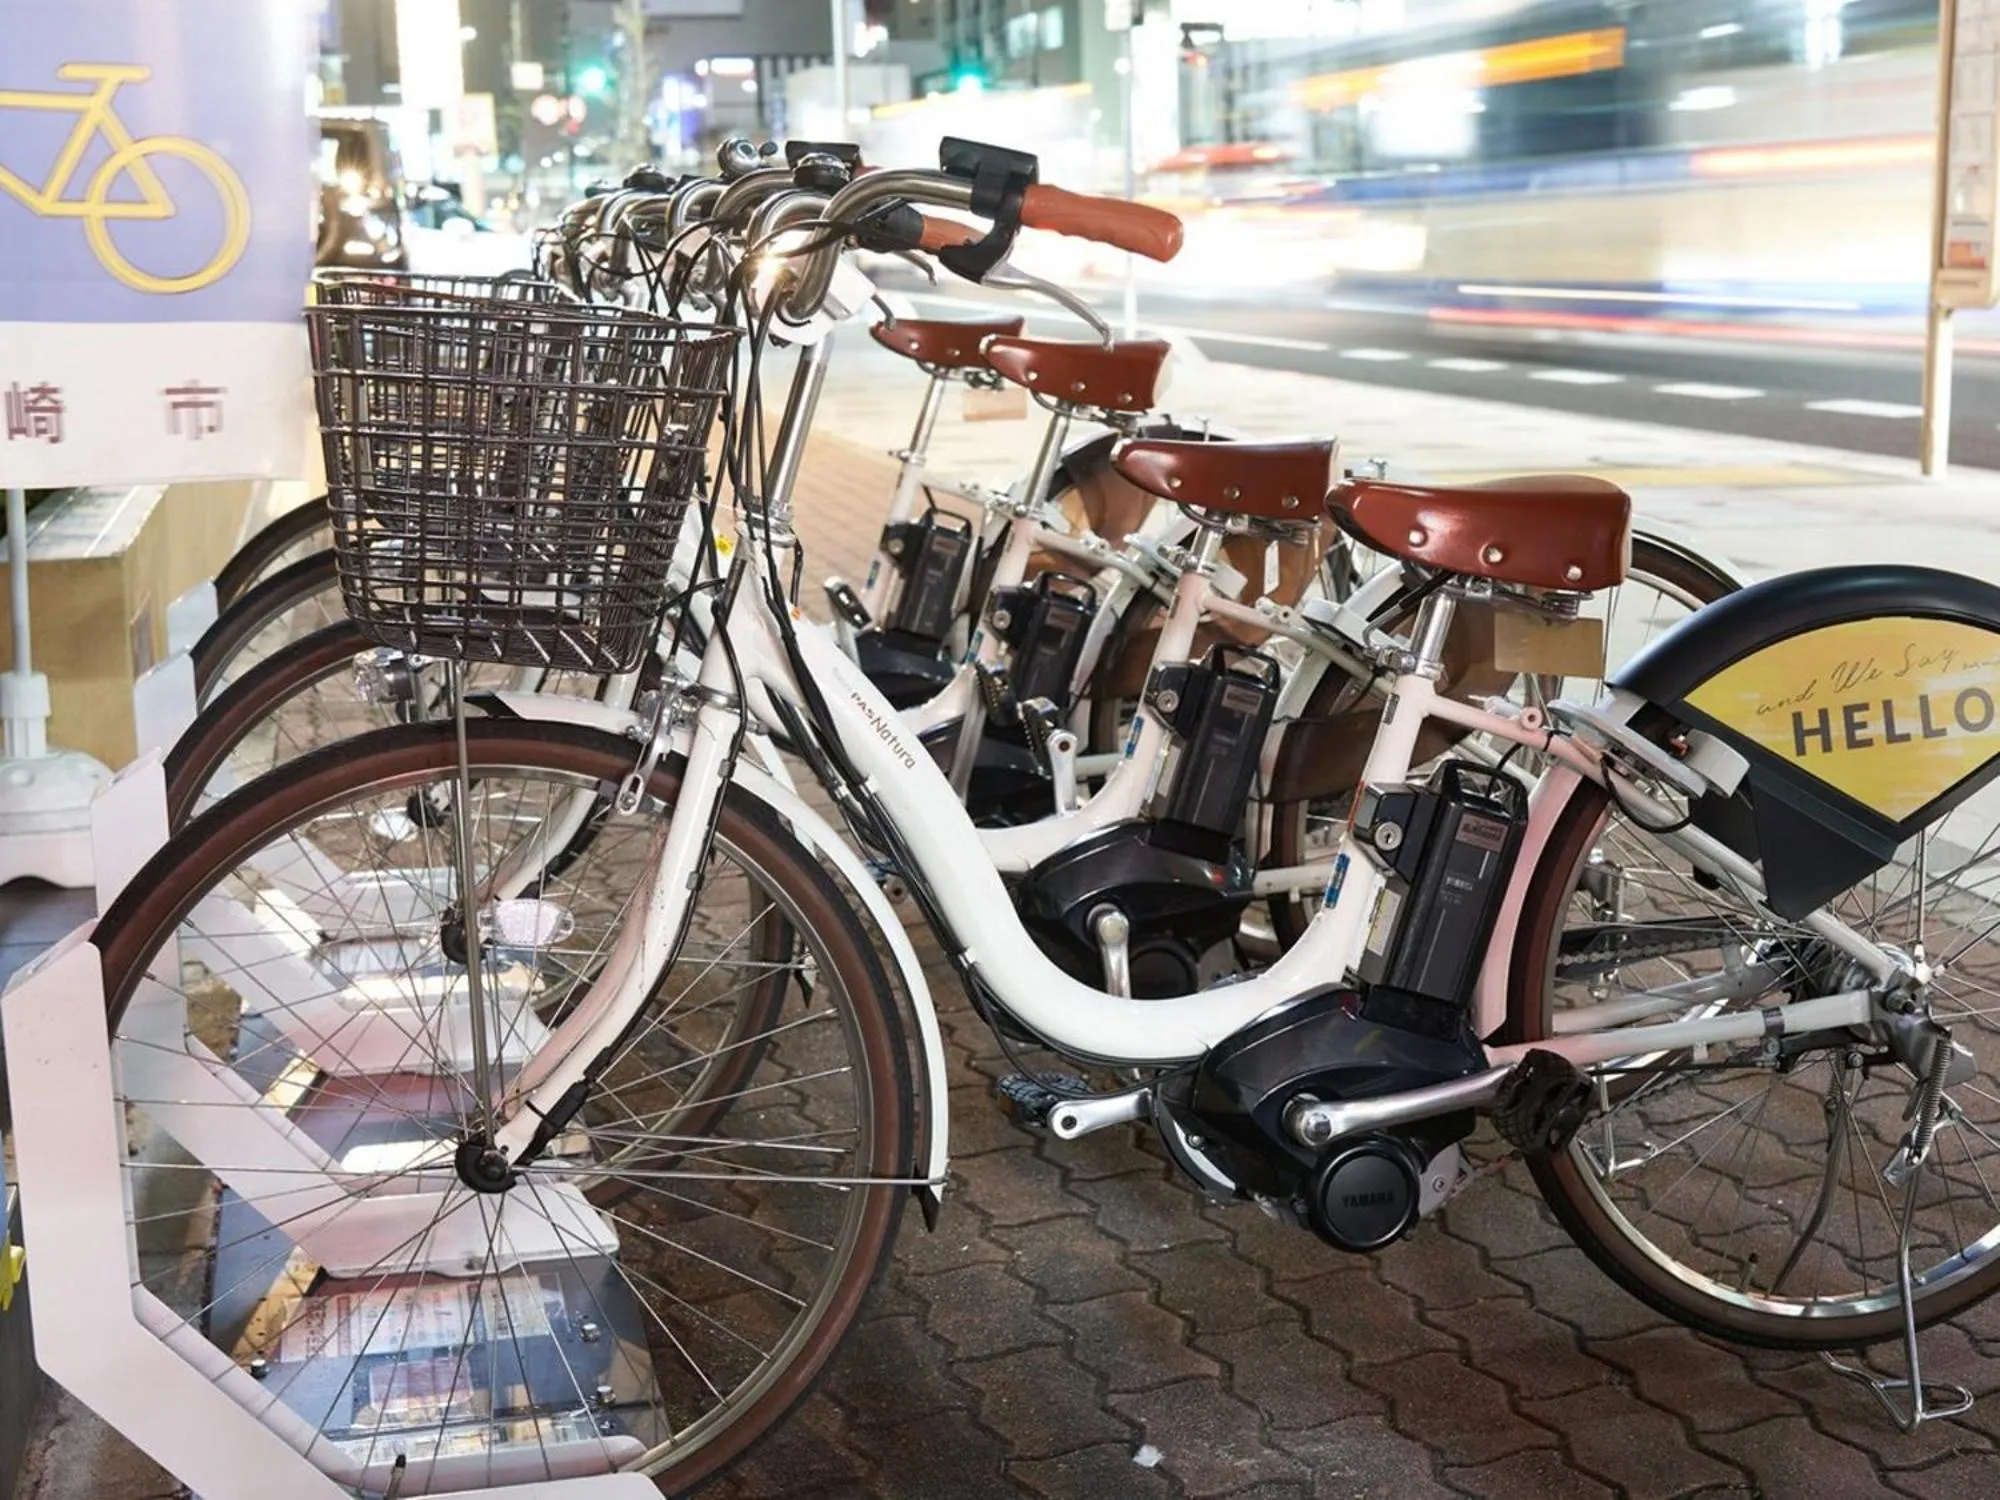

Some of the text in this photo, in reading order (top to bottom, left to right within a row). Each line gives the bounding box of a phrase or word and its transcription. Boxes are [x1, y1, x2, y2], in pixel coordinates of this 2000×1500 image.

[1755, 678, 1818, 716] and
[1830, 657, 1883, 694] We
[1791, 686, 1995, 757] HELLO
[1341, 1190, 1395, 1208] YAMAHA
